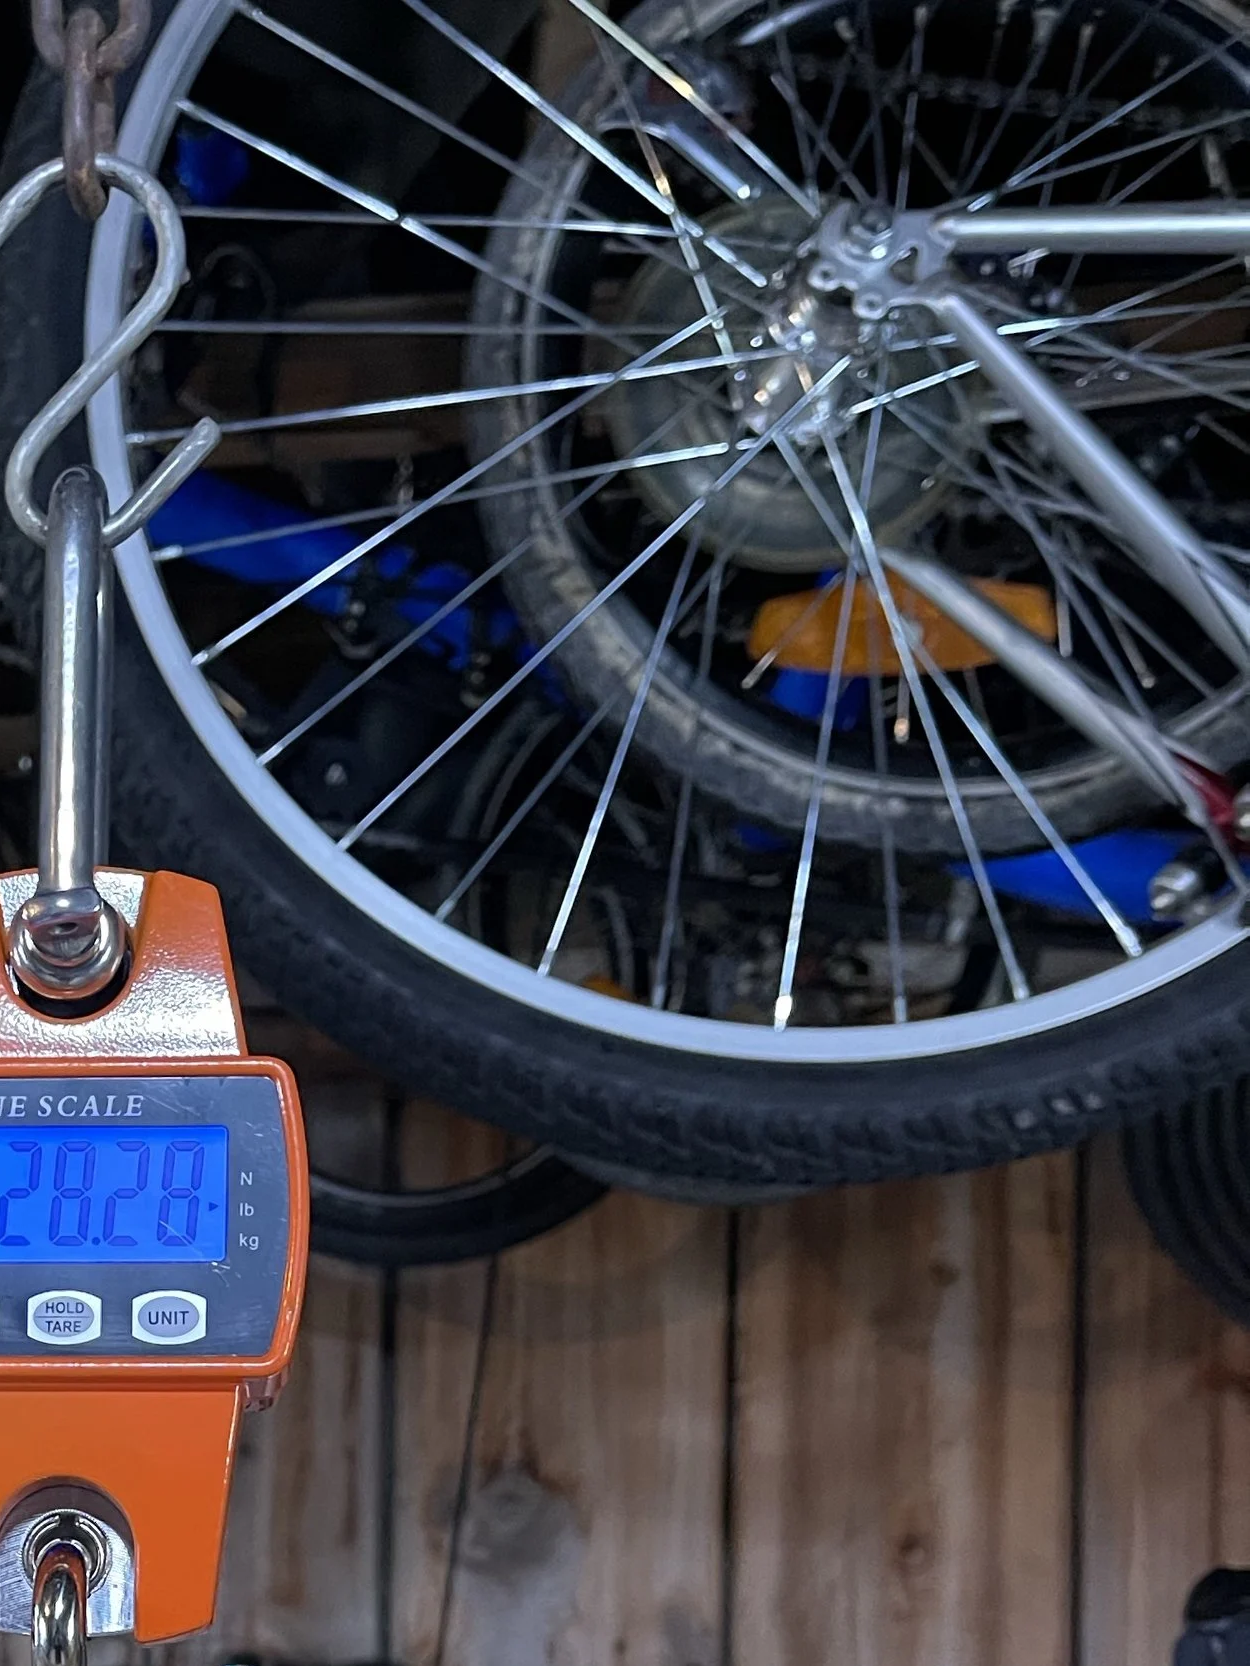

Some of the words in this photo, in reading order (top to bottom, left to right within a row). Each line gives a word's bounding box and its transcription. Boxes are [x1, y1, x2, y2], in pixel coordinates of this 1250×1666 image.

[37, 1095, 144, 1117] SCALE
[240, 1171, 253, 1186] N
[239, 1202, 254, 1216] lb
[239, 1232, 259, 1251] kg
[45, 1301, 85, 1314] HOLD
[148, 1310, 190, 1325] UNIT
[45, 1320, 82, 1333] TARE
